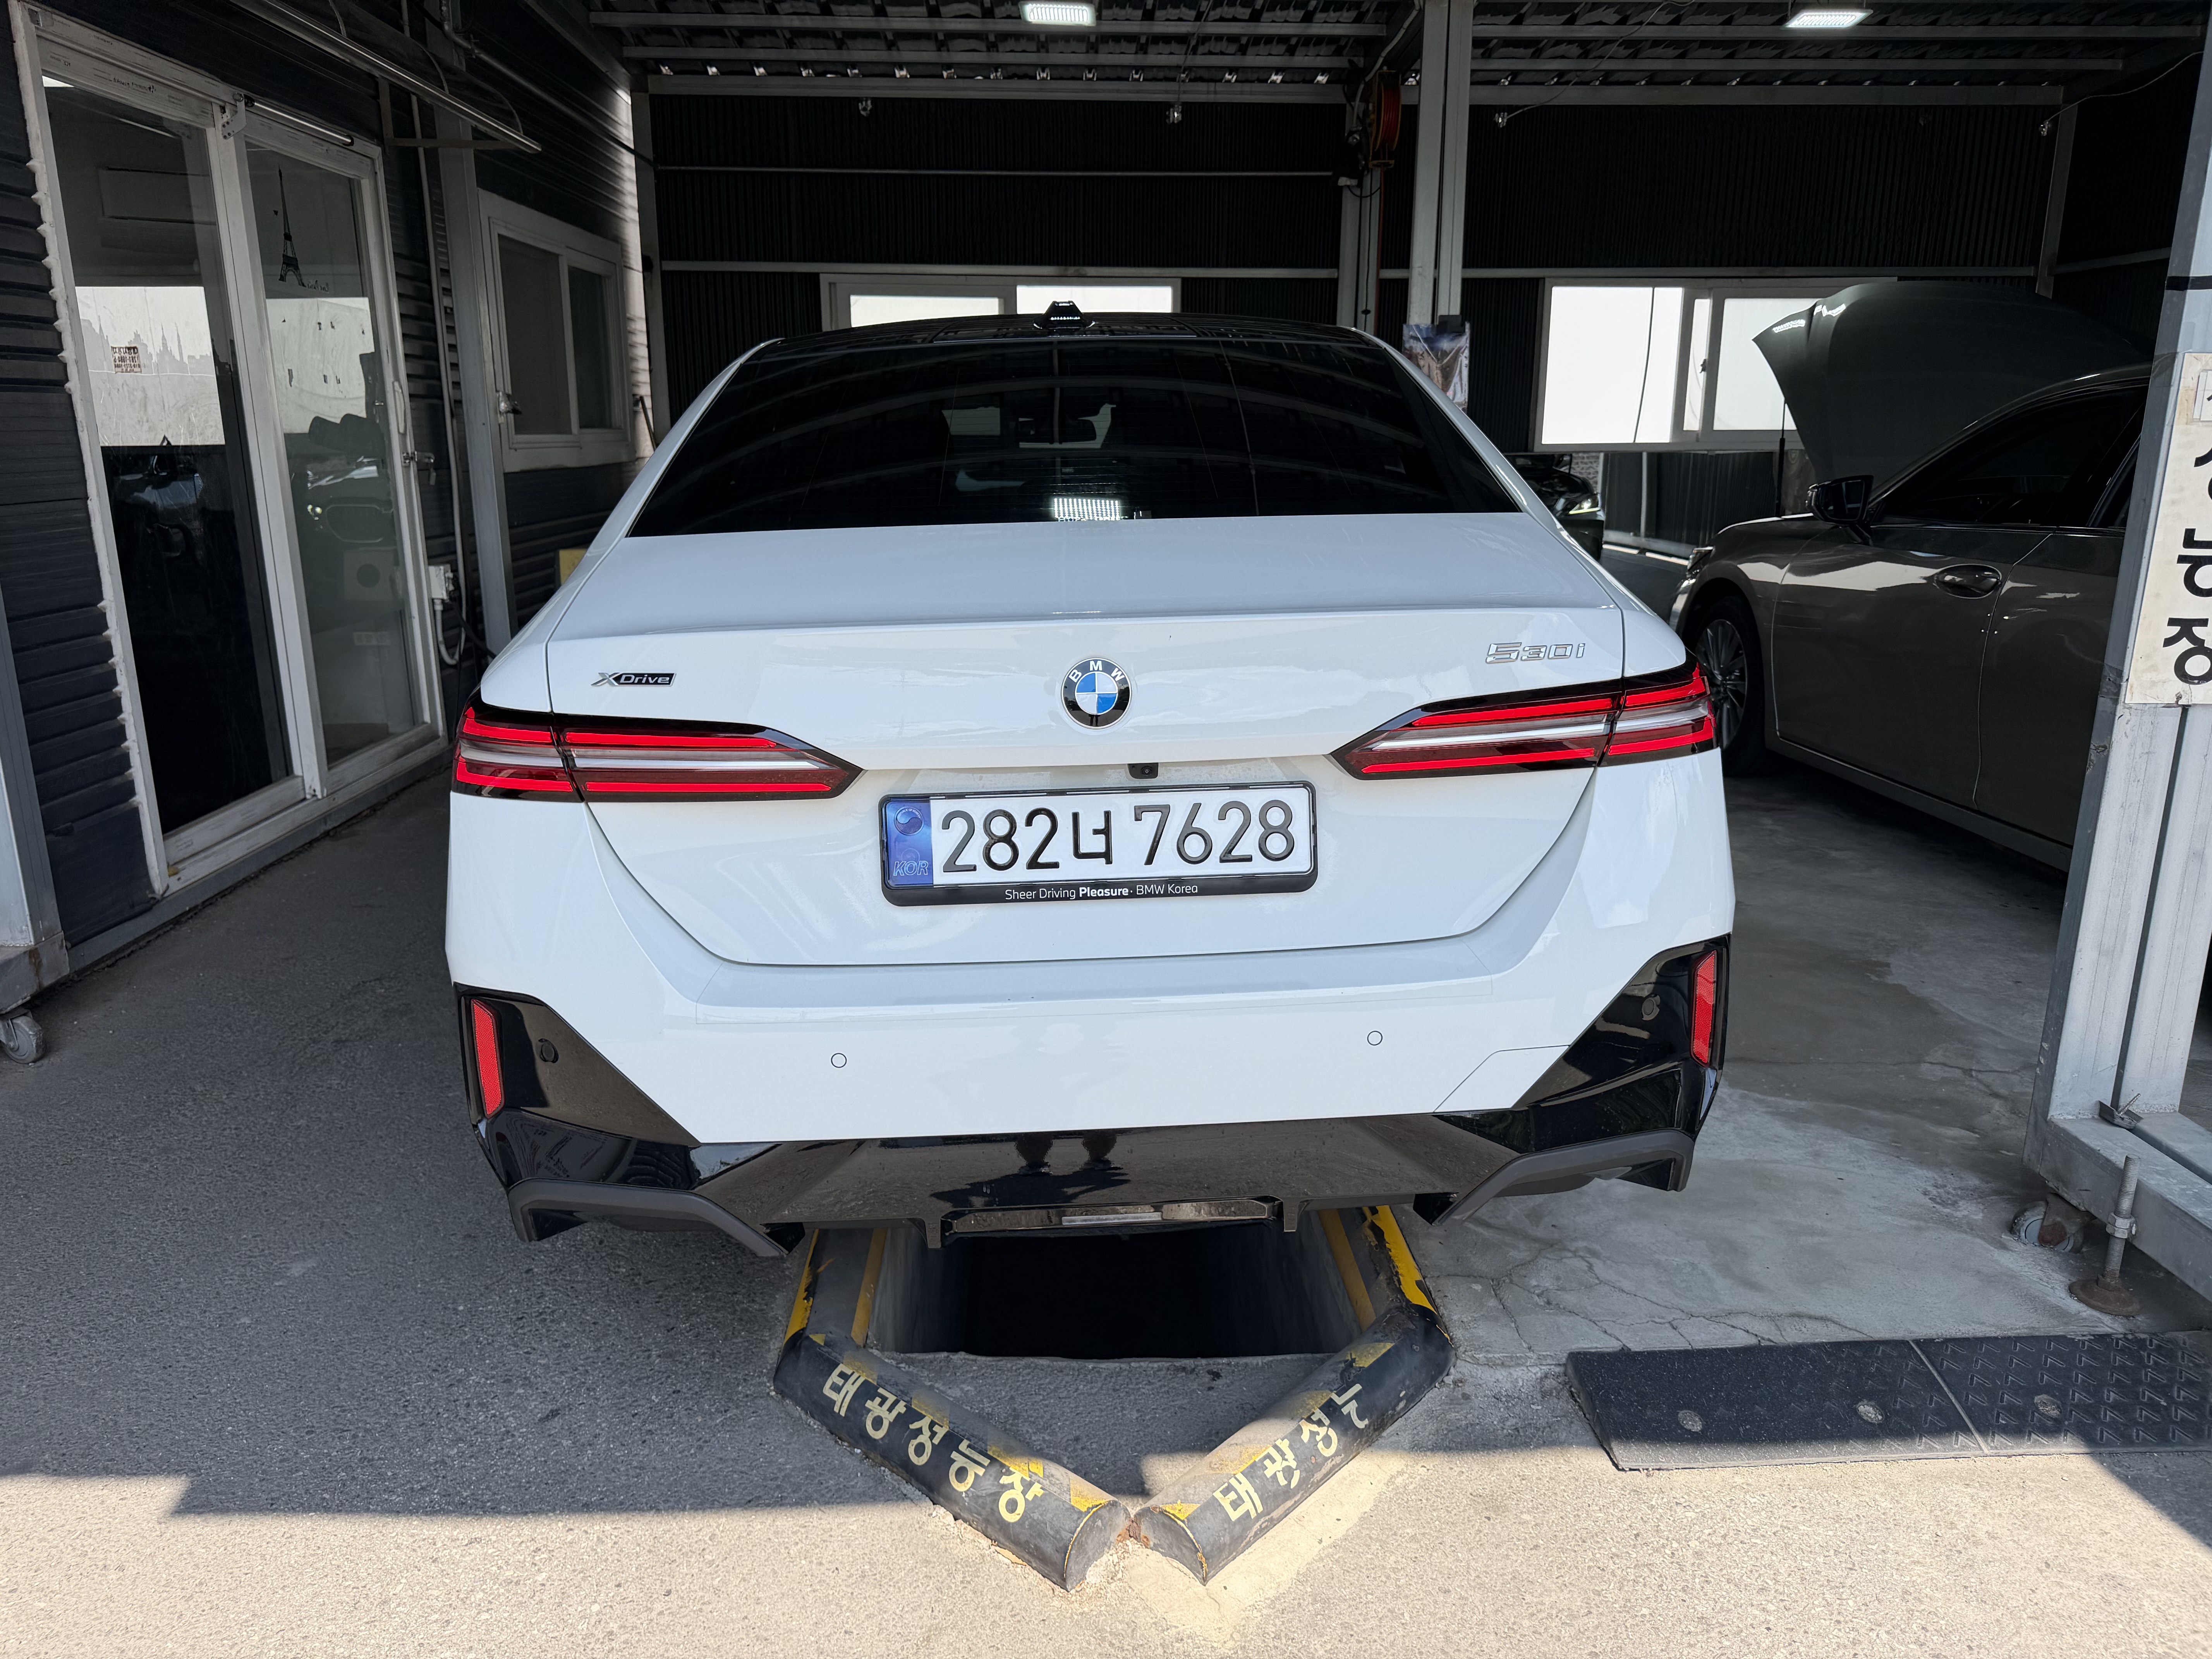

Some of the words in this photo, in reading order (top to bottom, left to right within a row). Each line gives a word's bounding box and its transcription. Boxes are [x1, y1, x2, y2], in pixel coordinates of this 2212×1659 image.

[1486, 642, 1586, 664] 530i
[1068, 661, 1125, 683] BMW
[941, 807, 1113, 873] 282너
[1134, 799, 1295, 865] 7628
[893, 860, 929, 876] KOR
[1005, 890, 1036, 900] Sheer
[1039, 888, 1076, 900] Driving
[1136, 884, 1164, 895] BMW
[1168, 884, 1198, 894] Korea
[822, 1363, 1044, 1523] 태광성능장
